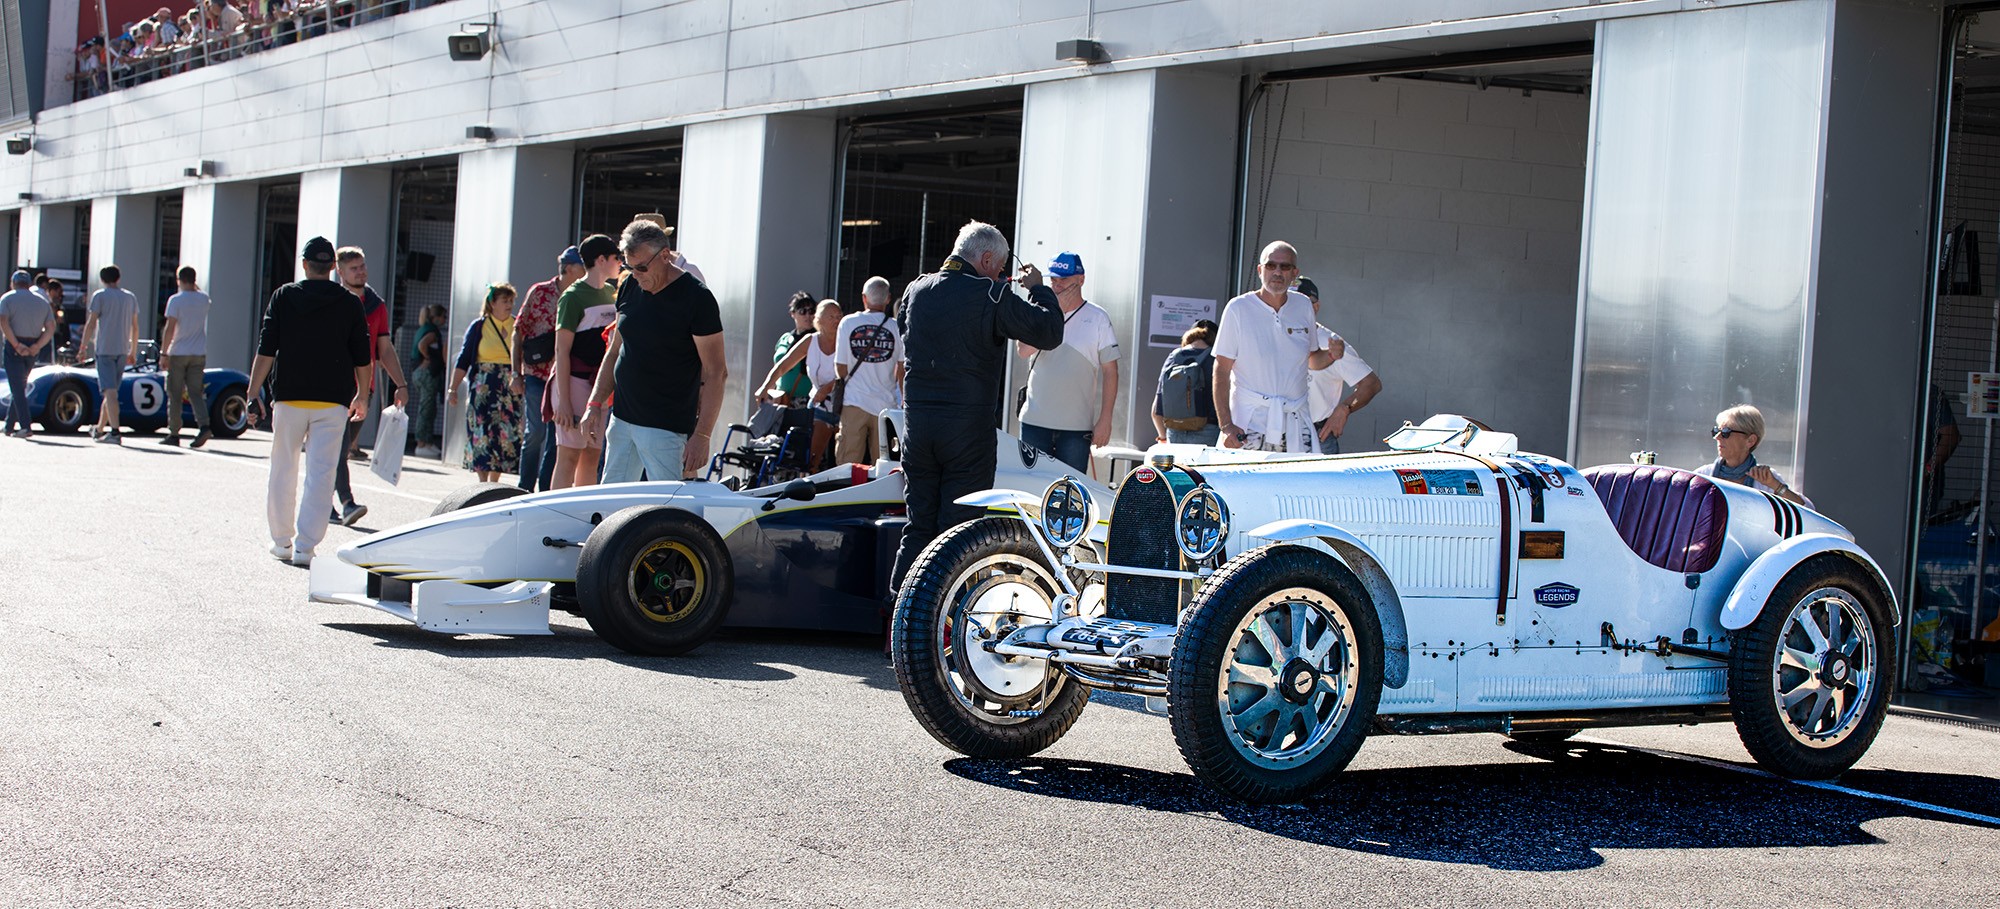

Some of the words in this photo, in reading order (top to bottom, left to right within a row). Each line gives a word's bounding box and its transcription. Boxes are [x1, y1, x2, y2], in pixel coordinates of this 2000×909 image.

[874, 340, 893, 350] LIFE
[141, 383, 155, 410] 3
[1547, 473, 1562, 487] 8
[1538, 593, 1576, 602] LEGENDS
[665, 613, 682, 622] OZ
